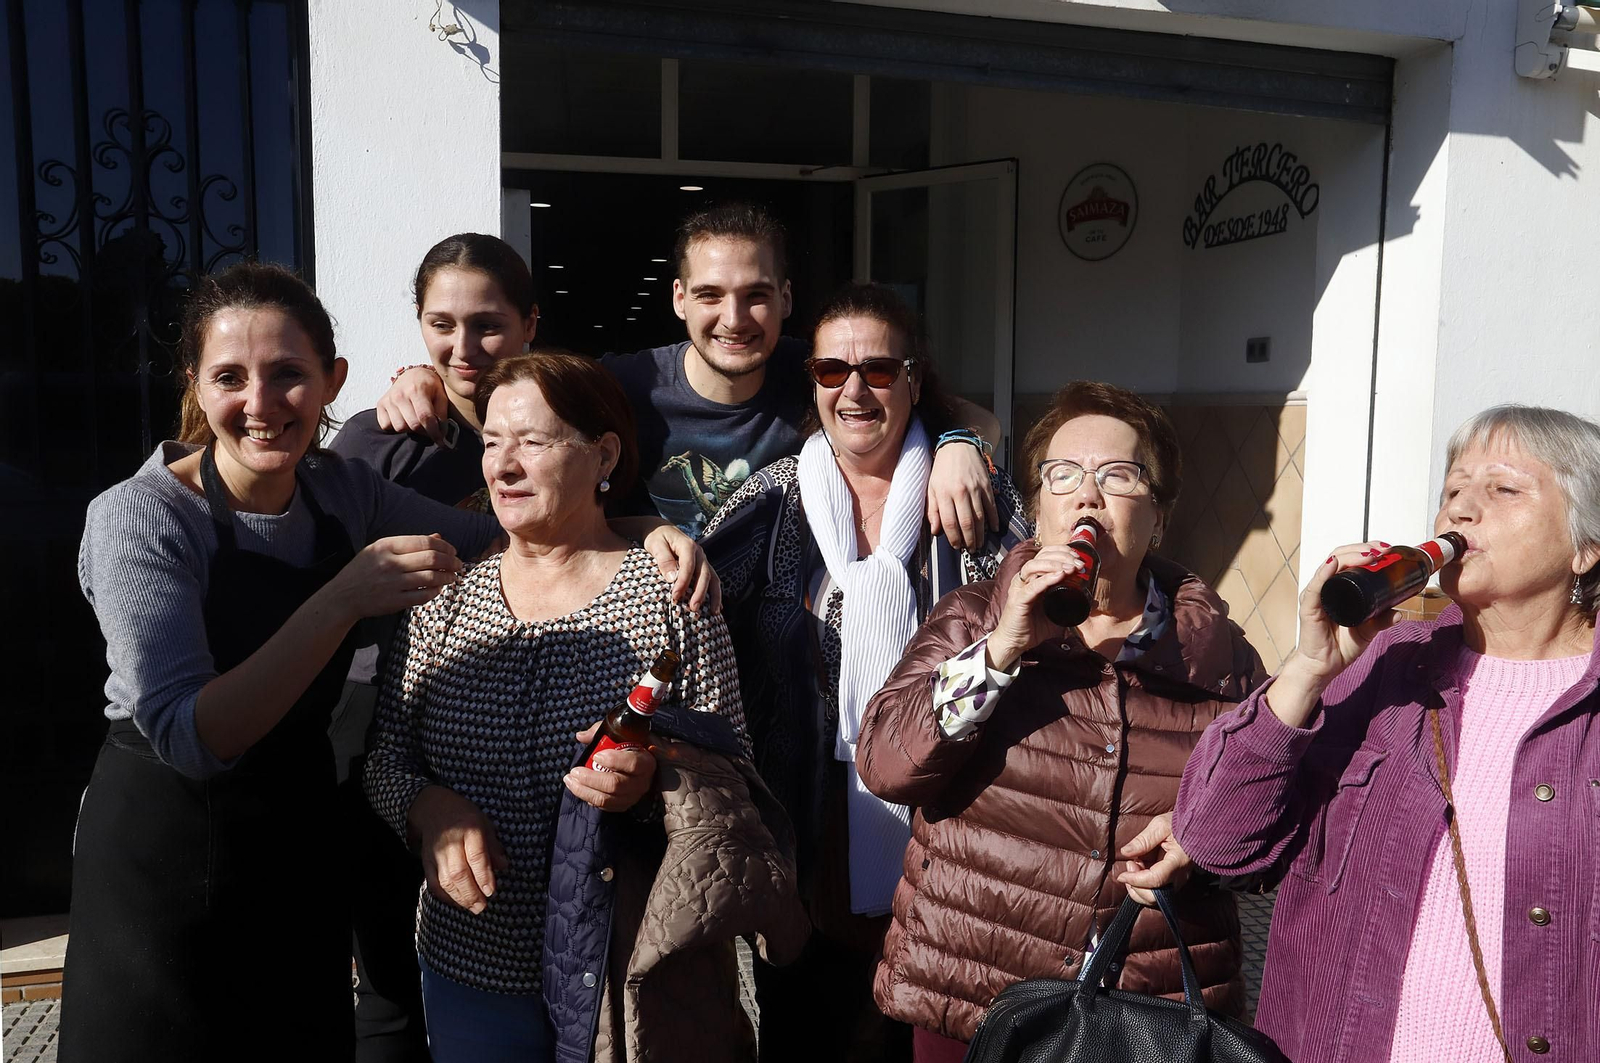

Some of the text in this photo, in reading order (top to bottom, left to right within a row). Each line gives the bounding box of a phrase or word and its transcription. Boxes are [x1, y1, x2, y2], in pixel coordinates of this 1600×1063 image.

[1069, 202, 1125, 221] SAIMAZA
[1183, 142, 1320, 249] BAR TERCERO
[1203, 203, 1289, 246] DESDE 1948
